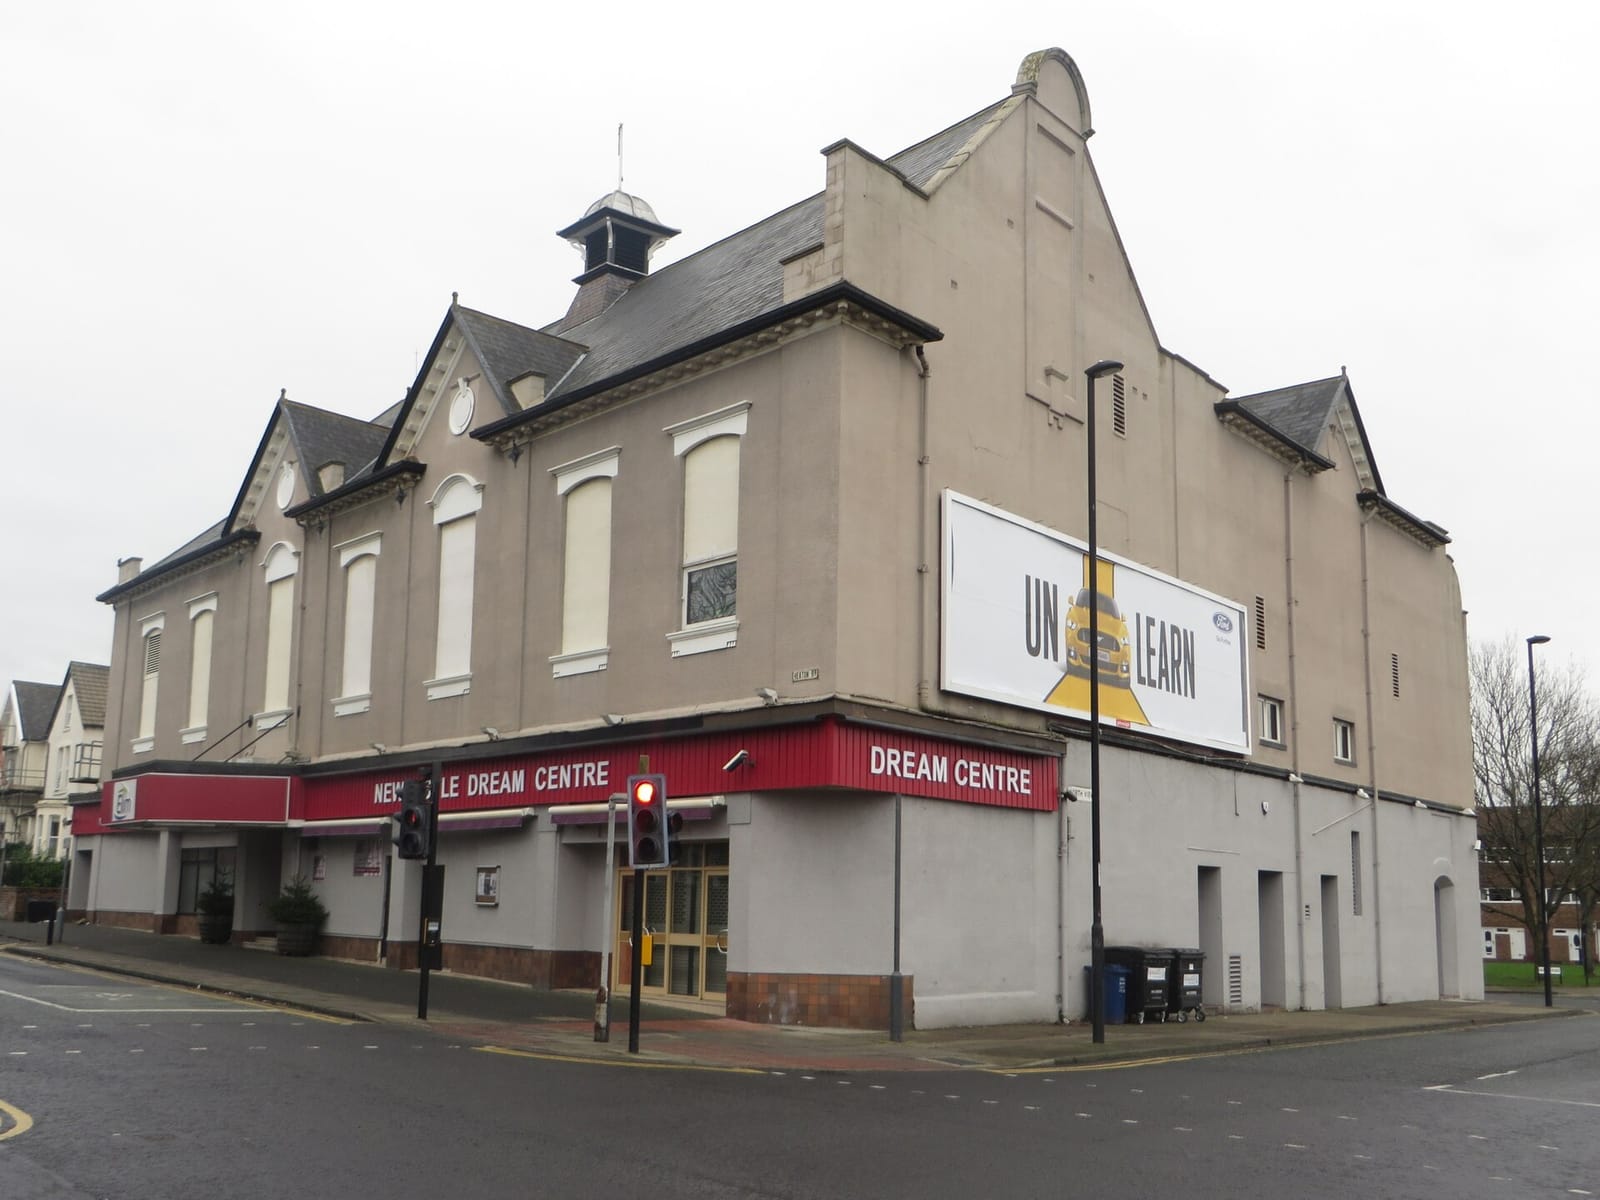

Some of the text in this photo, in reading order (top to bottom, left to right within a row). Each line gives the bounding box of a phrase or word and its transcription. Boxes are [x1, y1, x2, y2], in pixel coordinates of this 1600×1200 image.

[1026, 574, 1196, 701] UN LEARN
[1215, 613, 1231, 631] Ford
[374, 760, 609, 804] NEWLE DREAM CENTRE
[870, 745, 1032, 795] DREAM CENTRE
